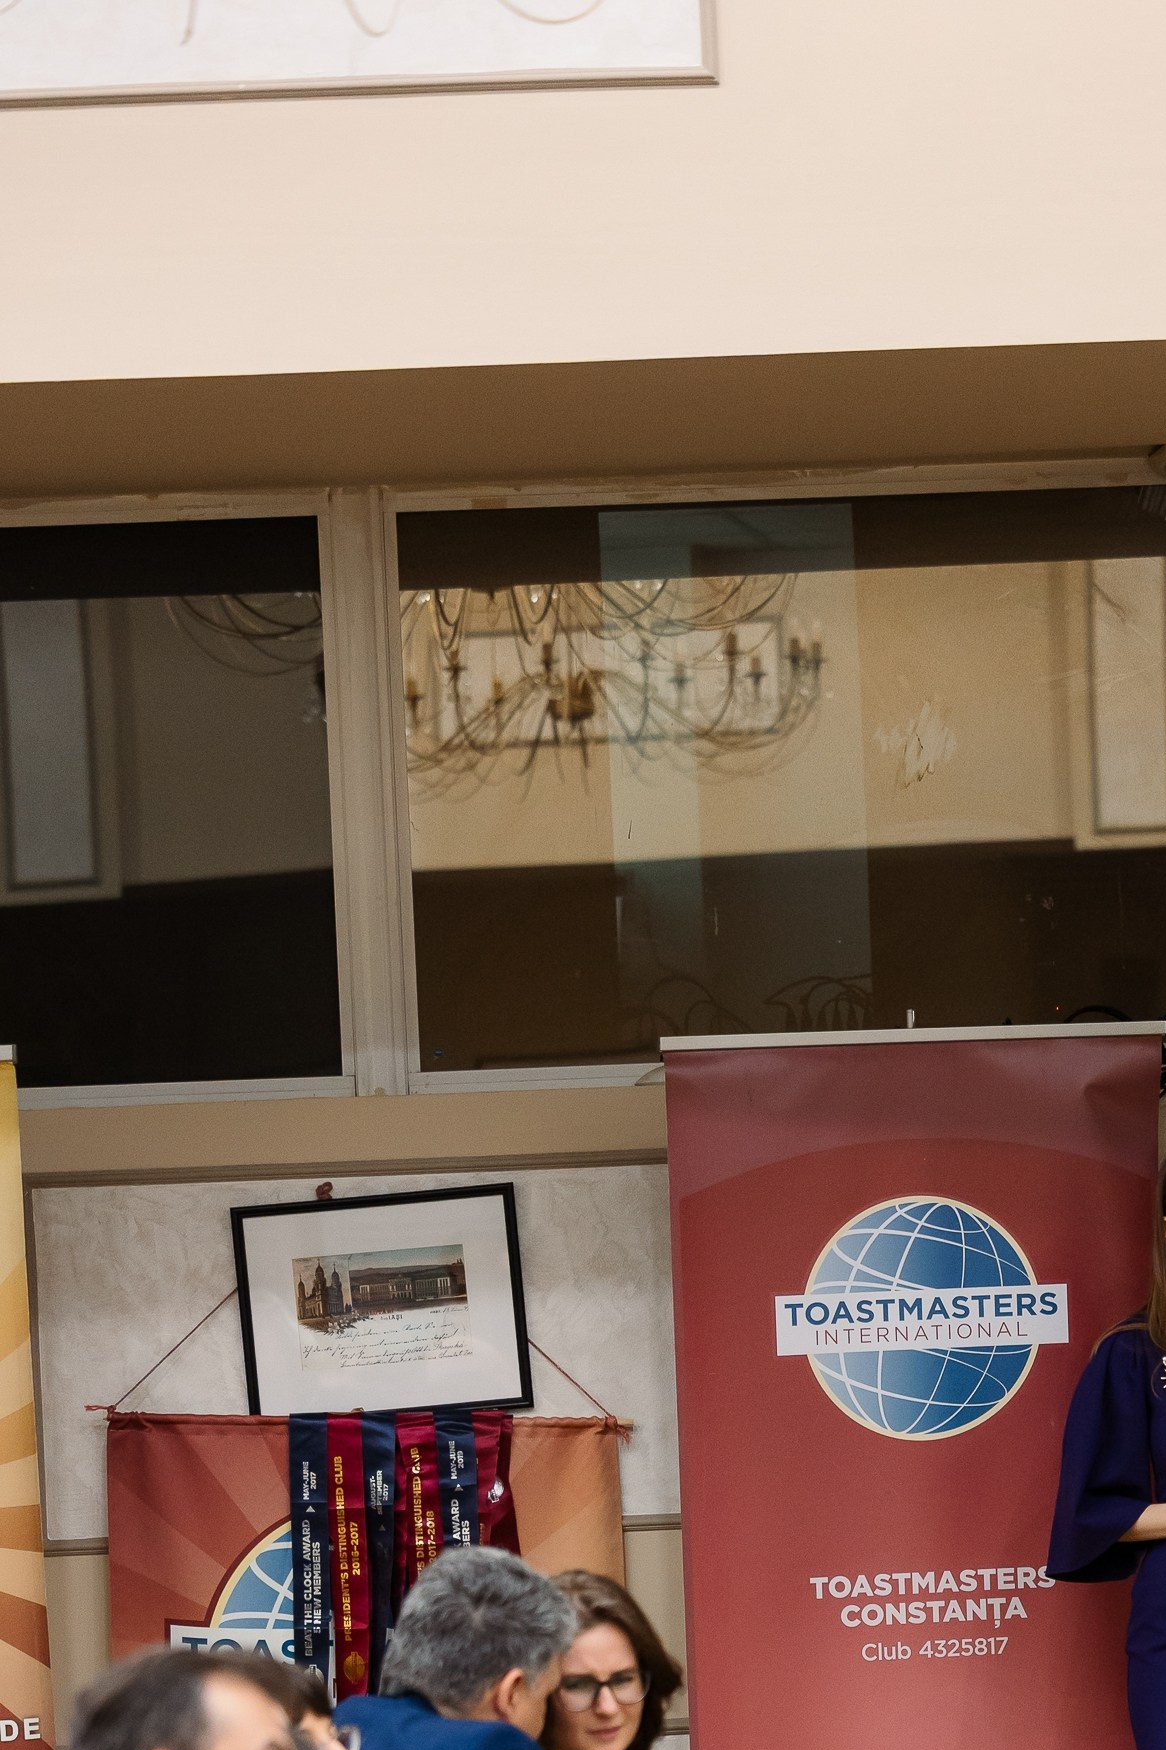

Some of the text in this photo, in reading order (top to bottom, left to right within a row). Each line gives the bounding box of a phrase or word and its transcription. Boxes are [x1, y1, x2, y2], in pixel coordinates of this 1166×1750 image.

[784, 1291, 1059, 1327] TOASTMASTERS
[815, 1321, 1029, 1346] INTERNATIONAL
[334, 1455, 344, 1485] CLUB
[448, 1440, 458, 1480] MAY-JUNE
[302, 1461, 310, 1500] MAY-JUNE
[335, 1487, 349, 1571] DISTINGUISHED
[450, 1499, 461, 1541] AWARD
[461, 1519, 471, 1548] BERS
[302, 1519, 311, 1561] AWARD
[303, 1564, 312, 1601] CLOCK
[312, 1541, 321, 1596] MEMBERS
[809, 1566, 1056, 1600] TOASTMASTERS
[303, 1603, 313, 1626] THE
[313, 1601, 321, 1625] NEW
[840, 1596, 1028, 1629] CONSTANȚA
[861, 1636, 1009, 1662] Club 4325817
